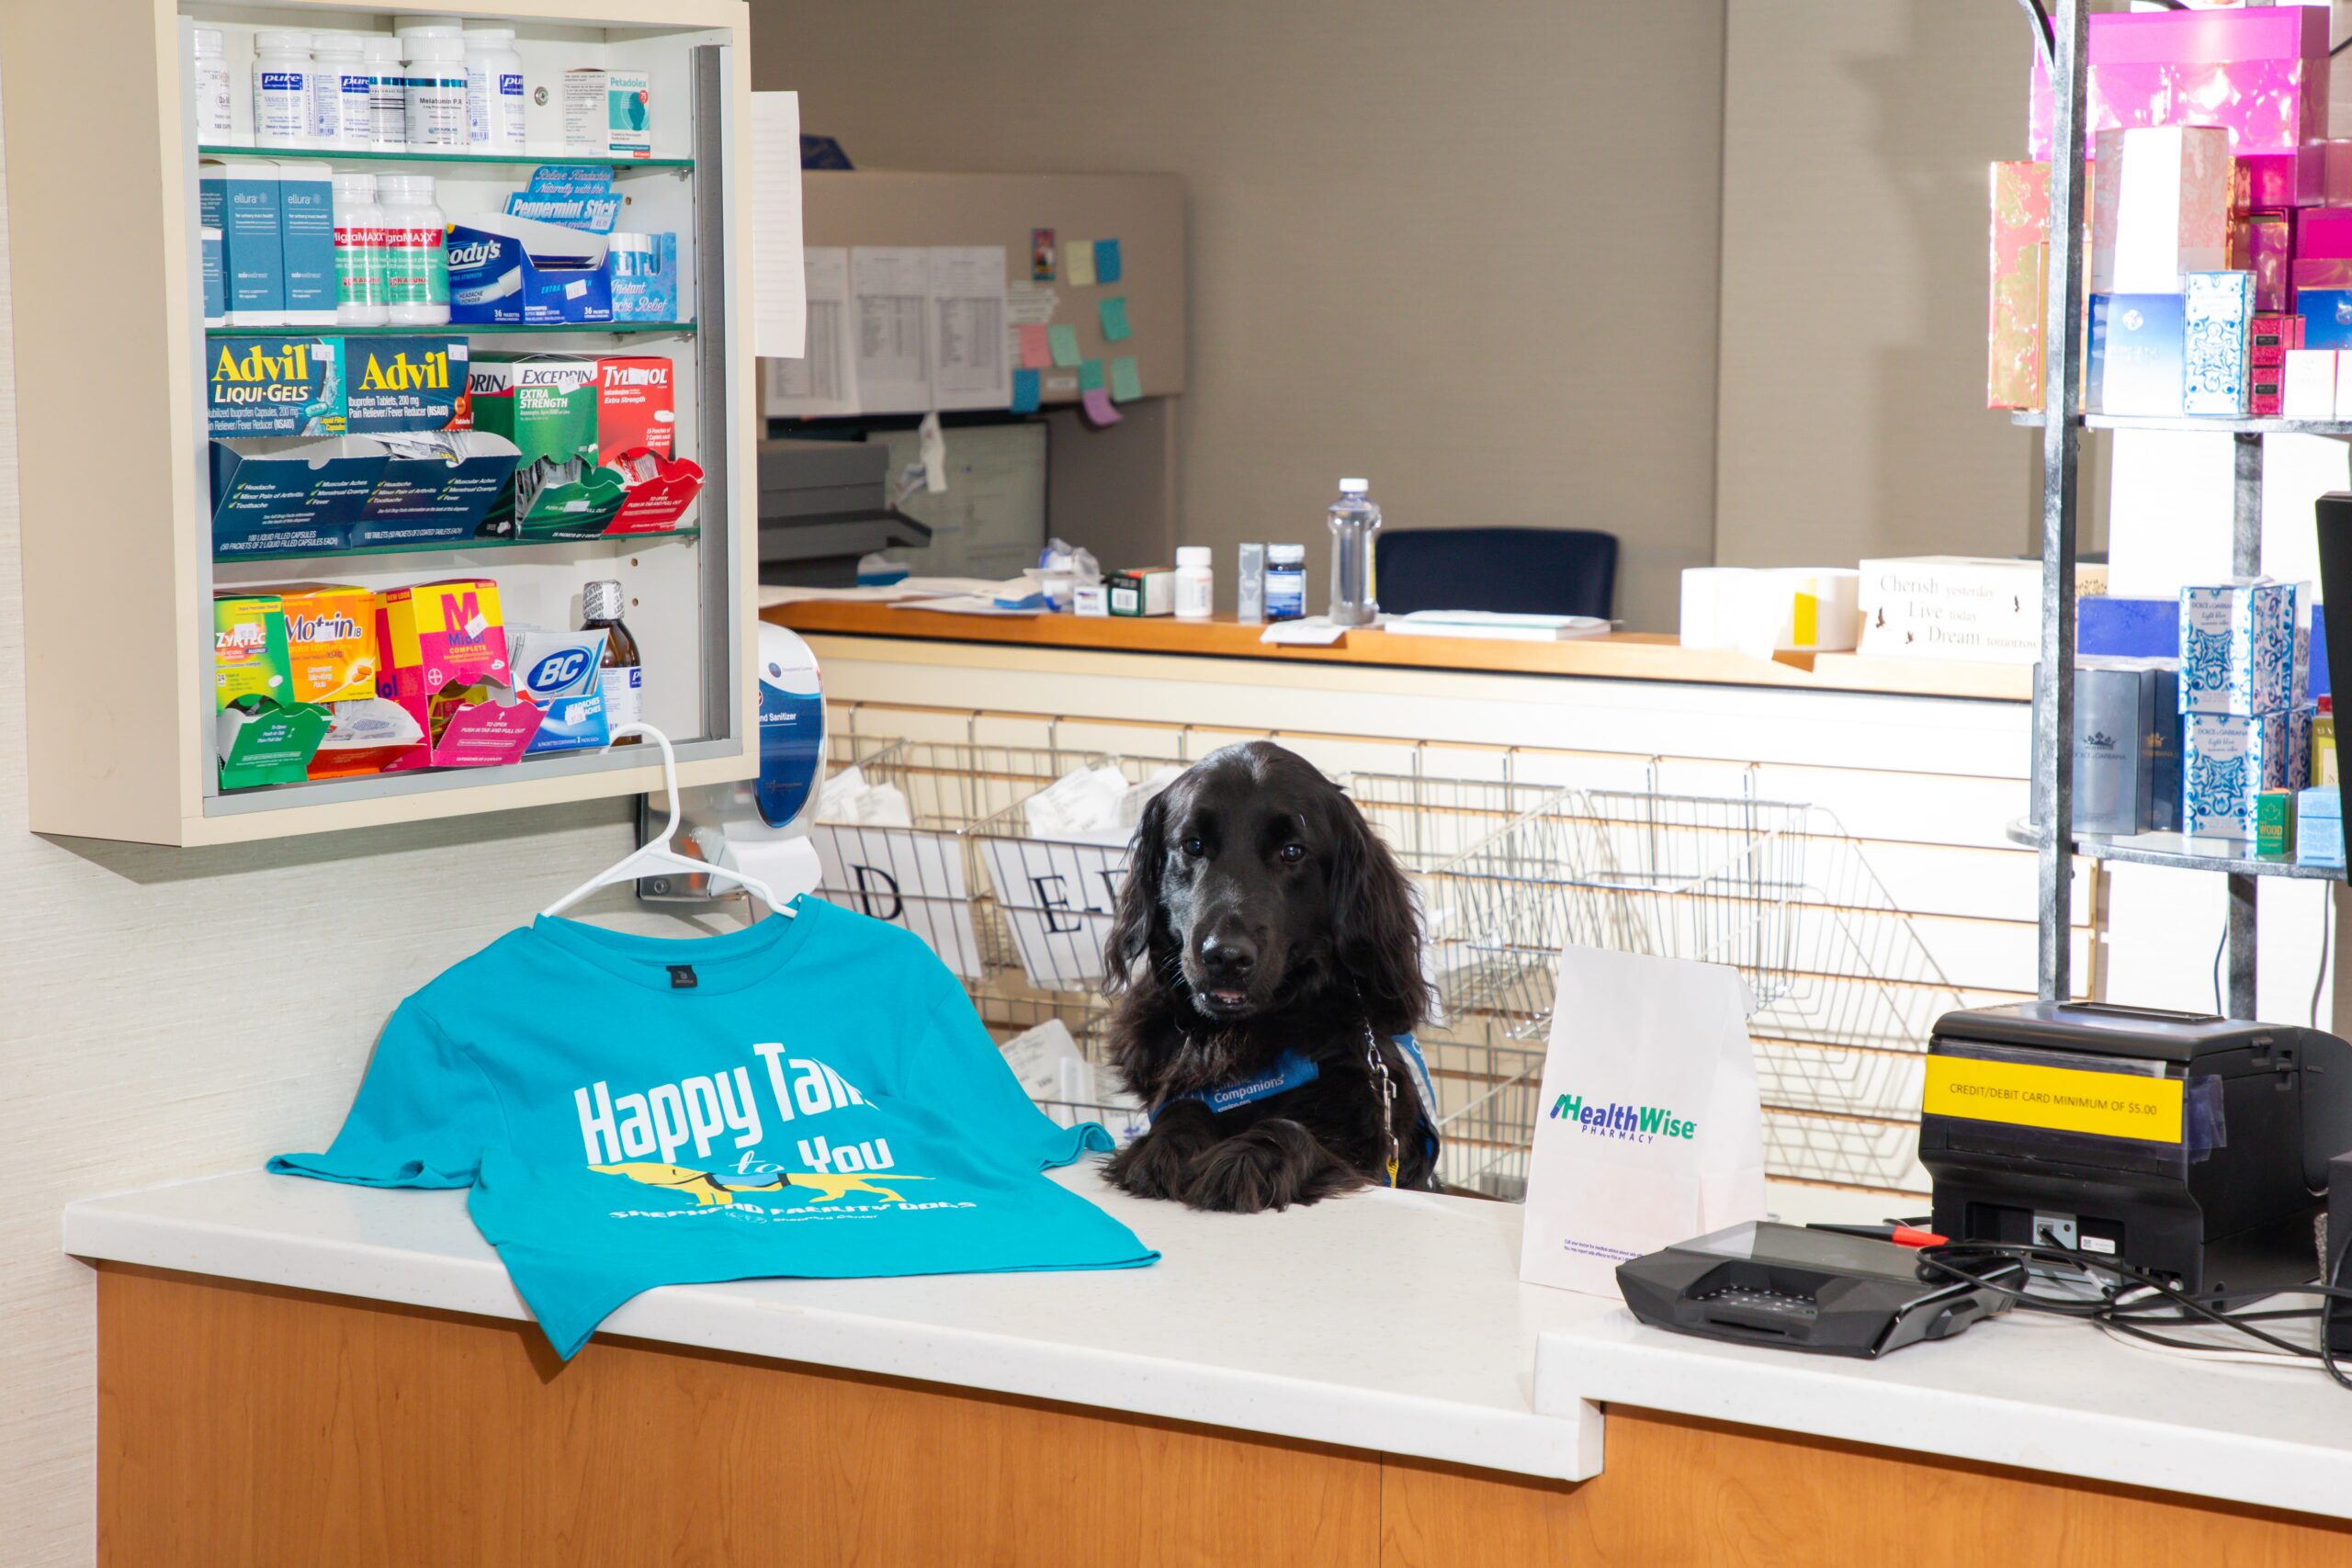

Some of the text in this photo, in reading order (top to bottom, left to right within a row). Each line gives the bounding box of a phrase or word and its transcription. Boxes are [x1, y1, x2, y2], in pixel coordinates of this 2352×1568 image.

[264, 73, 300, 84] pure
[610, 77, 647, 87] Petadolex
[234, 193, 257, 203] ellura
[288, 194, 311, 204] ellura
[513, 198, 616, 219] Peppermint Stick
[447, 240, 501, 266] ody's
[541, 285, 560, 294] EXTRA
[211, 344, 309, 382] Advil
[358, 351, 449, 390] Advil
[348, 397, 375, 408] Ibuprofen
[399, 396, 409, 405] 200
[520, 389, 548, 399] EXTRA
[520, 399, 568, 409] STRENGTH
[621, 396, 646, 404] Strength
[349, 408, 362, 418] Pain
[404, 406, 426, 417] Reducer
[427, 405, 448, 417] (NSAID)
[1881, 575, 1995, 598] Cherish yesterday
[1909, 601, 1977, 622] Live today
[1929, 626, 2036, 649] Dream tomorrow
[449, 645, 486, 653] COMPLETE
[536, 653, 584, 687] BC
[769, 712, 797, 721] Sanitizer
[2259, 825, 2283, 835] WOOD
[848, 865, 904, 920] D
[1215, 1077, 1283, 1102] Companions
[1950, 1083, 2157, 1116] CREDIT/DEBIT CARD MINIMUM OF $5.00
[573, 1066, 763, 1164] Happy
[1560, 1093, 1694, 1140] HealthWise
[1581, 1124, 1654, 1145] PHARMACY
[727, 1149, 785, 1176] to
[797, 1135, 895, 1175] You
